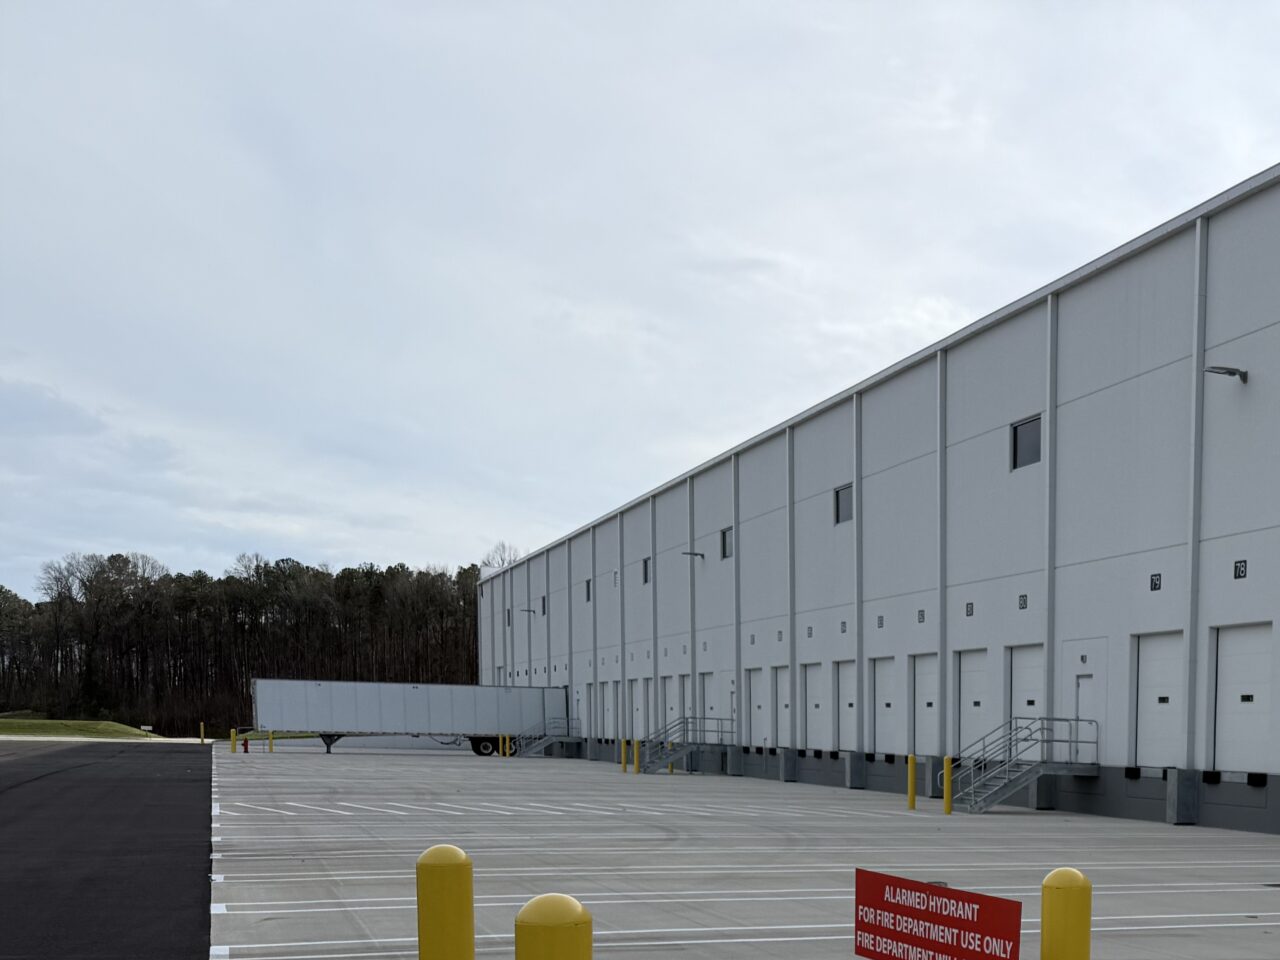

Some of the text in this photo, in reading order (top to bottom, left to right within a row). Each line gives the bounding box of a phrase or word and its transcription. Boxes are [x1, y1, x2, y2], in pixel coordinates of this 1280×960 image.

[1235, 561, 1246, 577] 78
[1151, 575, 1160, 590] 79
[884, 885, 980, 922] ALARMED HYDRANT
[857, 931, 875, 950] FIRE
[858, 905, 1014, 960] FOR FIRE DEPARTMENT USE ONLY
